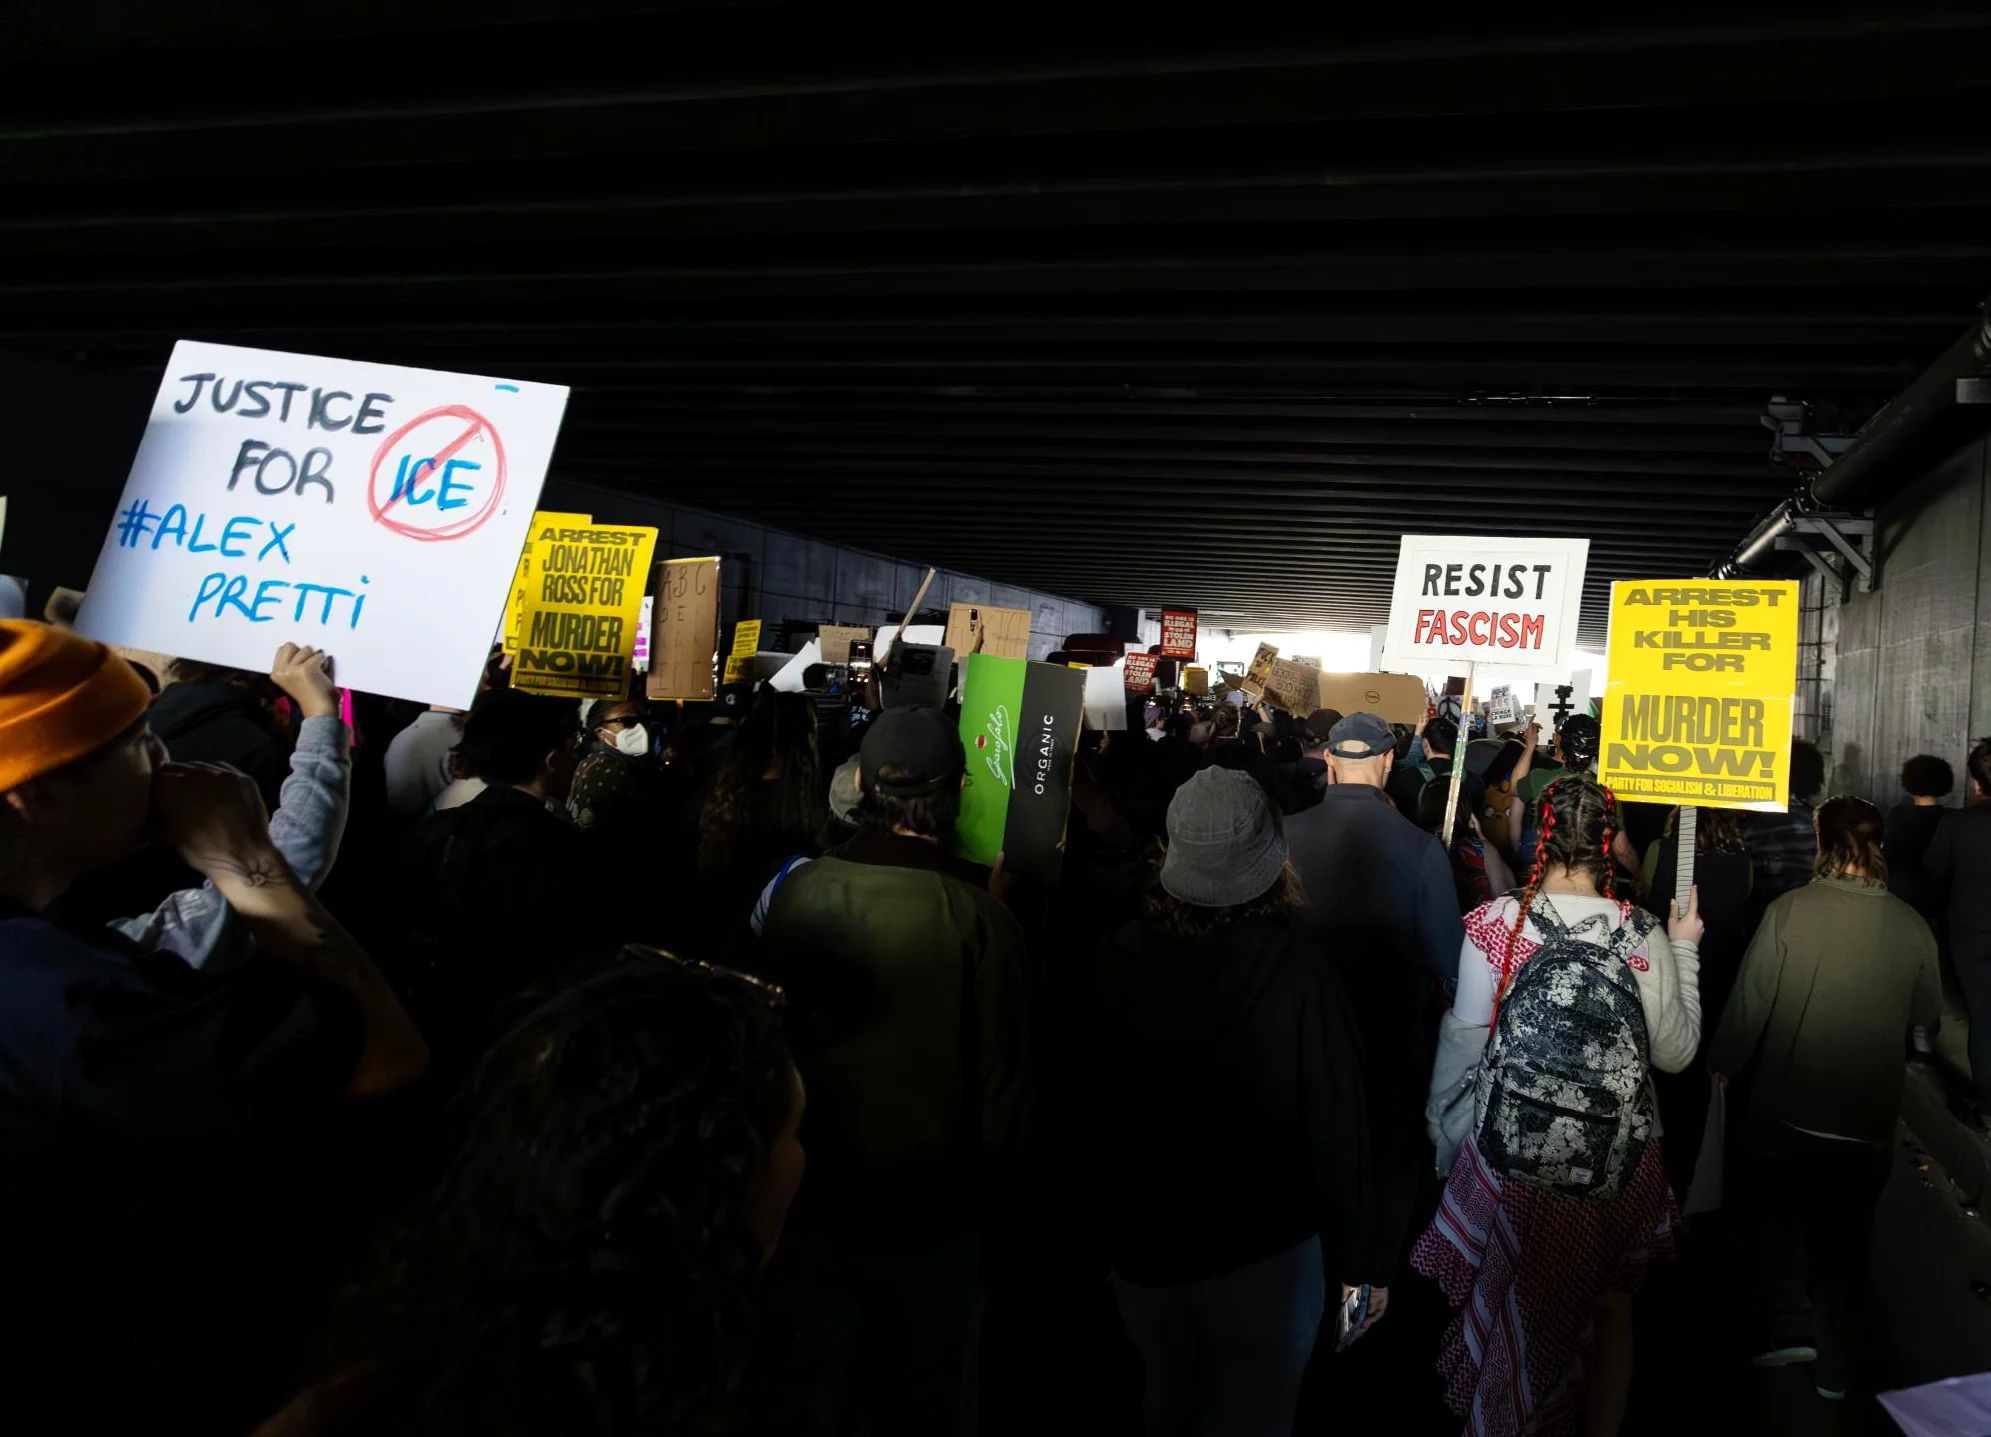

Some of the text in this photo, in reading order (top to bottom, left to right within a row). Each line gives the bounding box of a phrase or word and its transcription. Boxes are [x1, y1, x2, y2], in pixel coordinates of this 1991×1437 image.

[173, 372, 395, 434] JUSTICE
[227, 439, 335, 504] FOR
[389, 454, 482, 510] ICE
[117, 499, 296, 564] #ALEX
[539, 528, 647, 546] ARREST
[542, 545, 635, 577] JONATHAN
[541, 574, 625, 607] ROSS FOR
[1421, 563, 1552, 600] RESIST
[1623, 588, 1787, 607] ARREST
[529, 611, 624, 654] MURDER
[1164, 620, 1195, 628] ILLEGAL
[1413, 609, 1545, 650] FASCISM
[1668, 609, 1736, 628] HIS
[1164, 632, 1193, 640] STOLEN
[1164, 638, 1193, 648] LAND
[1633, 630, 1771, 650] KILLER
[518, 650, 624, 677] NOW!
[1663, 653, 1745, 672] FOR
[1620, 694, 1765, 748] MURDER
[986, 705, 1015, 790] Garofalo
[1034, 714, 1054, 795] ORGANIC
[1607, 743, 1776, 778] NOW!
[1607, 776, 1773, 800] PARTY FOR SOCIALISM & LIBERATION
